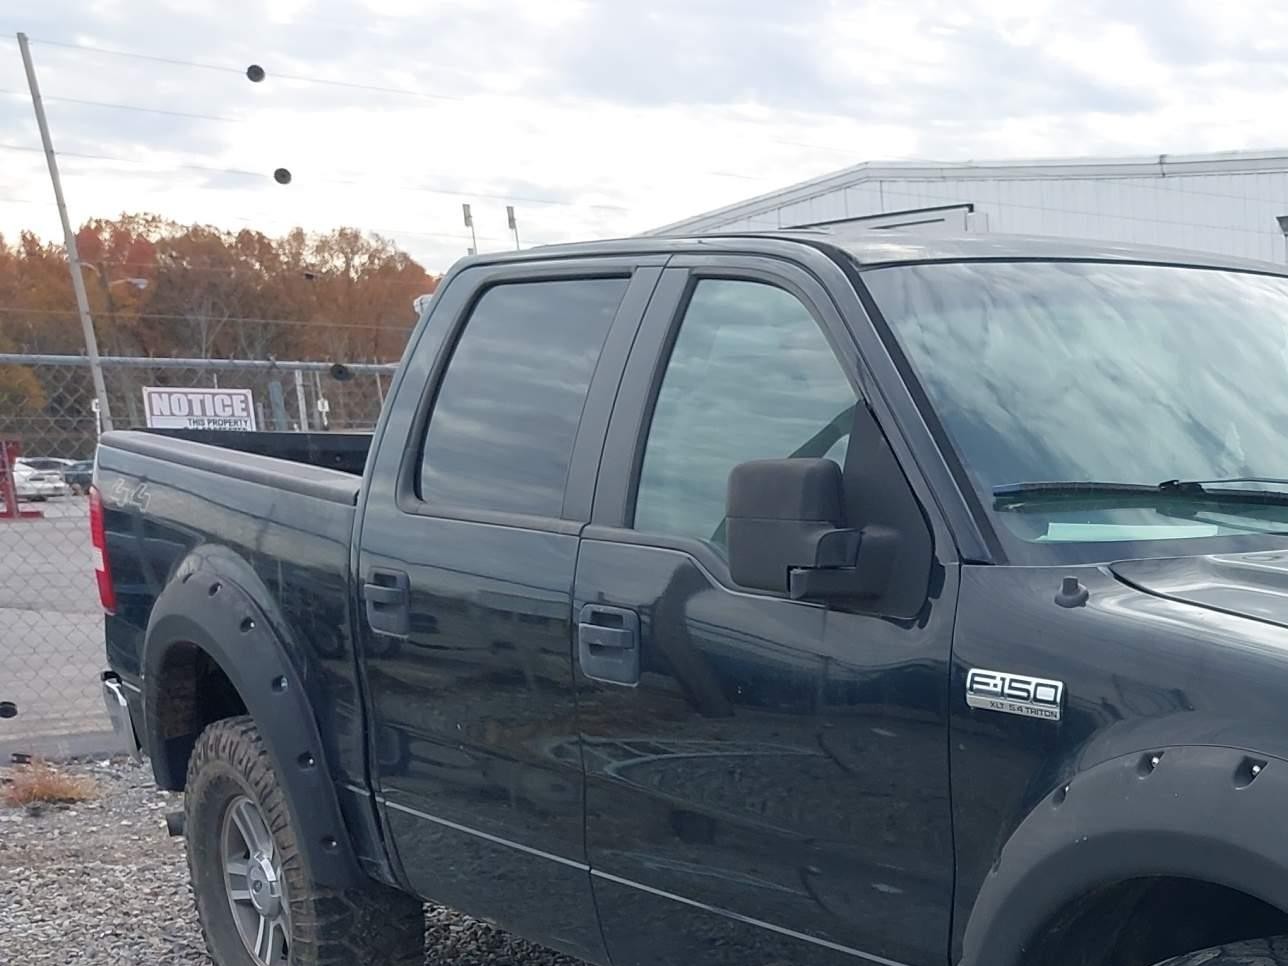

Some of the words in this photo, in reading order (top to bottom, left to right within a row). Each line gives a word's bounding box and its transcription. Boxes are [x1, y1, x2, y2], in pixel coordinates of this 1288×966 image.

[151, 393, 248, 417] NOTICE
[187, 418, 205, 426] THIS
[207, 418, 249, 428] PROPERTY
[990, 701, 1004, 710] XLT
[1024, 707, 1058, 719] TRITON
